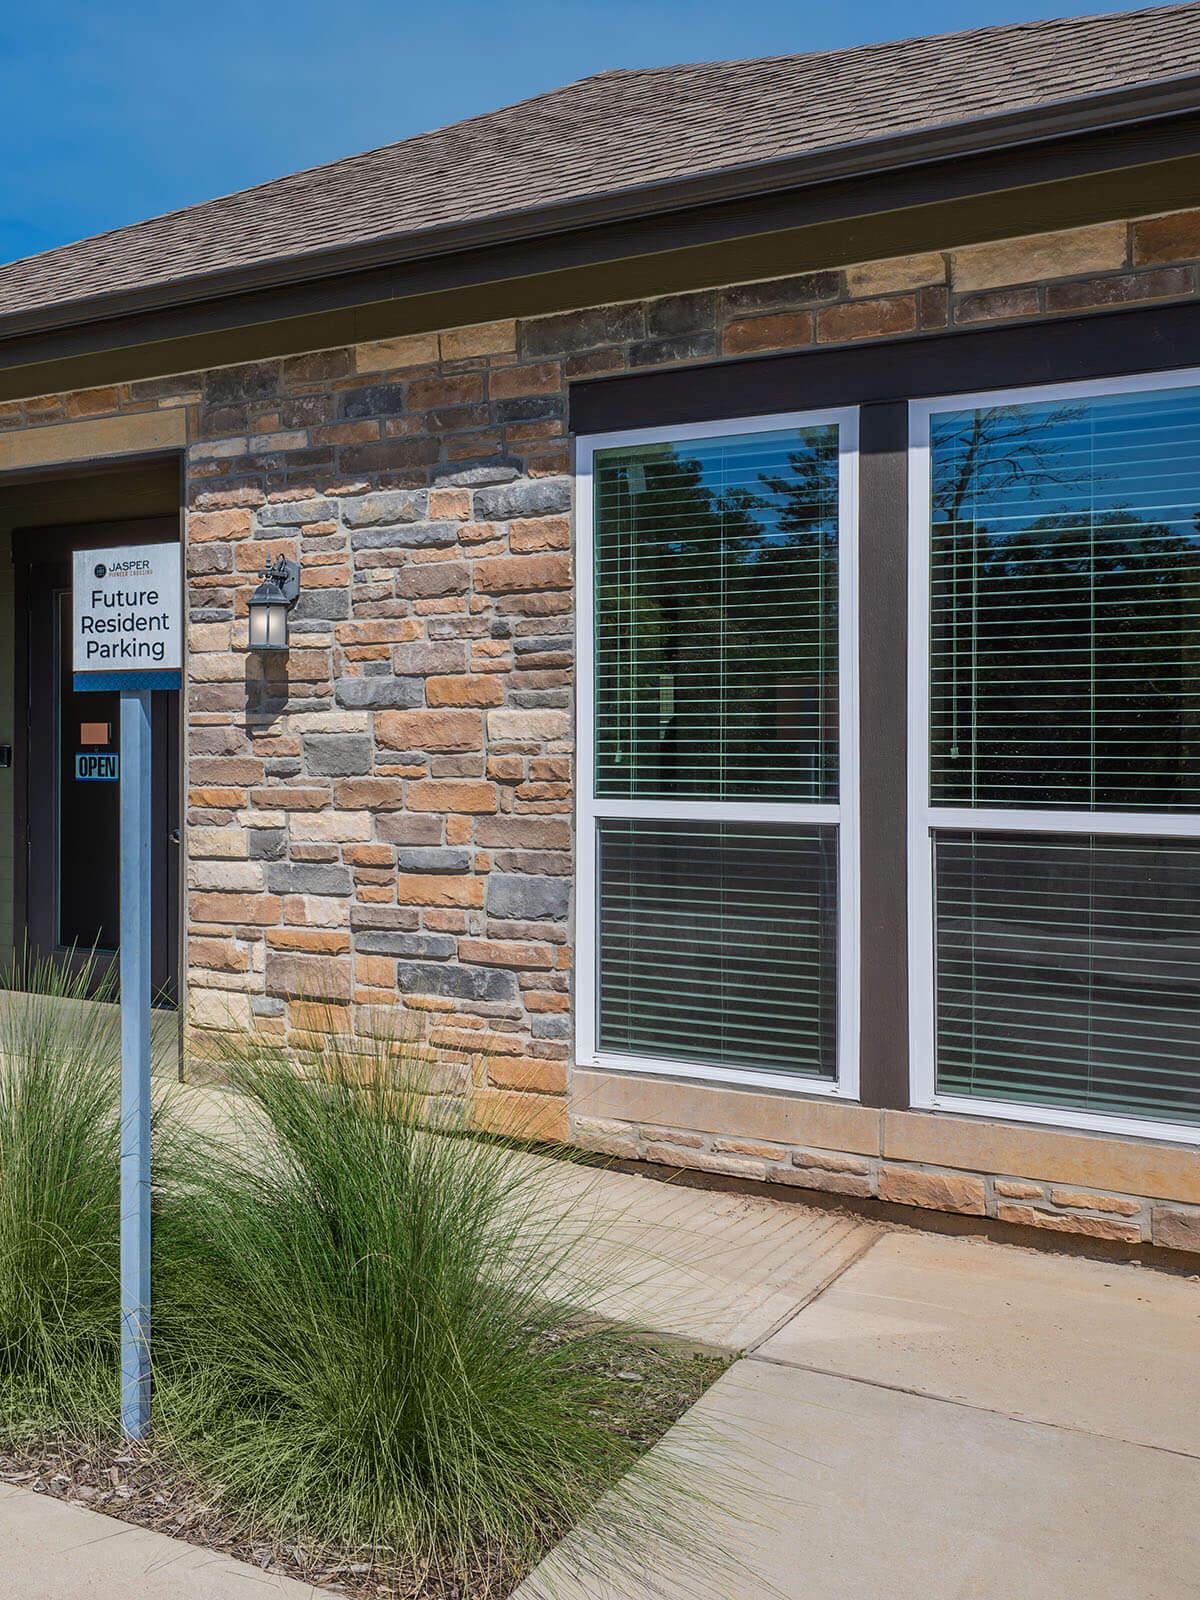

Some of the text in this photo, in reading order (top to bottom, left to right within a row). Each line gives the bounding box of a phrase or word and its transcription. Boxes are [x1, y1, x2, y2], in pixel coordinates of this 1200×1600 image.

[109, 560, 150, 572] JASPER
[92, 590, 159, 608] Future
[81, 612, 170, 634] Resident
[87, 638, 165, 661] Parking
[79, 756, 116, 777] OPEN
